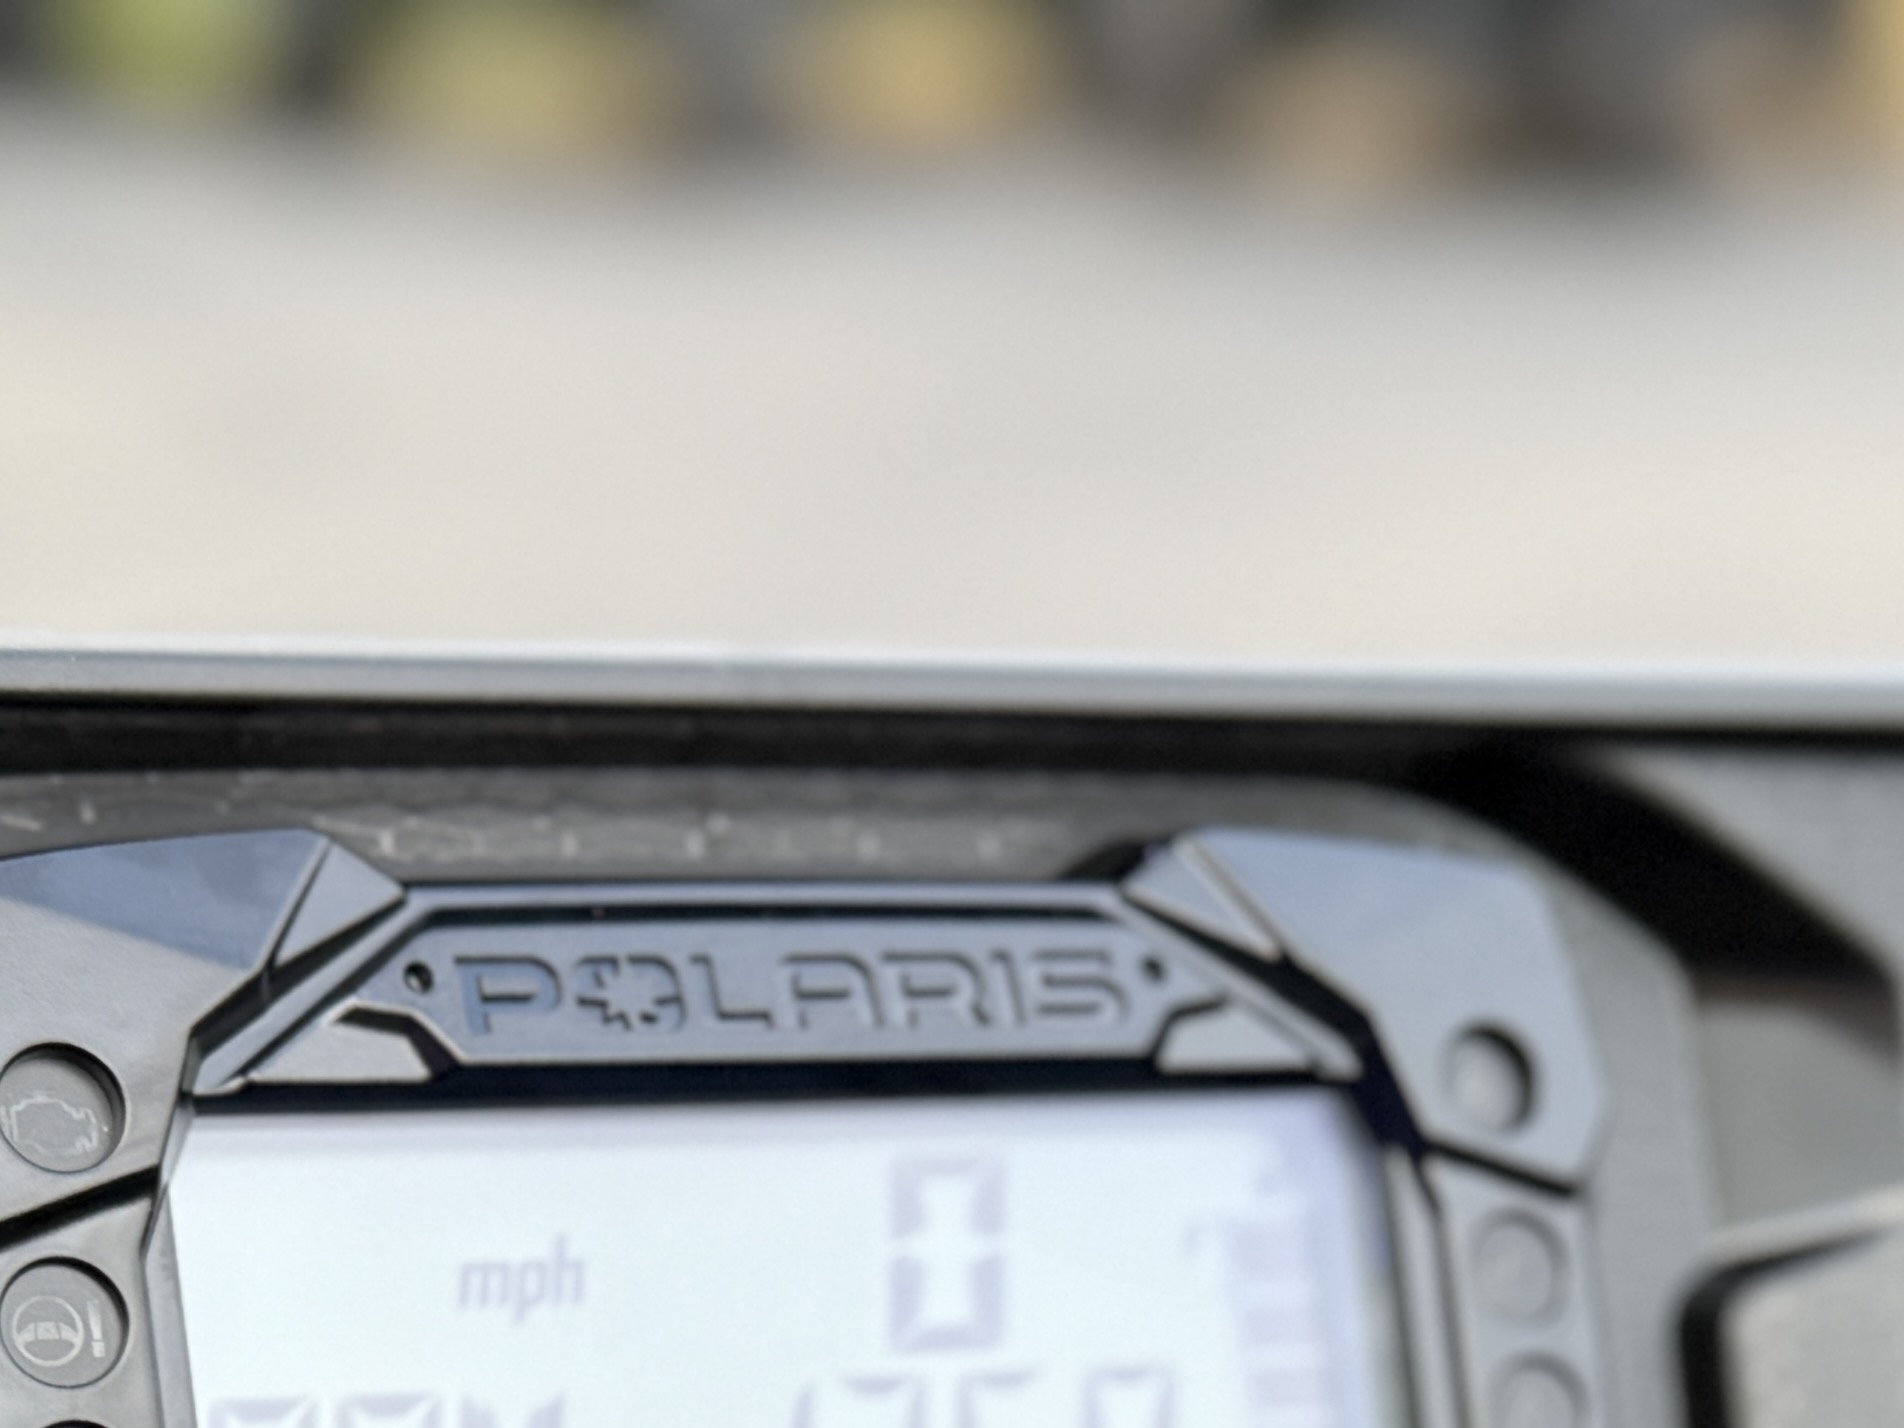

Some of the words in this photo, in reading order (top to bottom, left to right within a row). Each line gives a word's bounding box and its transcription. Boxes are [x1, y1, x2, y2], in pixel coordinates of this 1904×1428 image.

[453, 949, 1130, 1035] POLARIS
[456, 1231, 588, 1326] mph
[889, 1154, 1007, 1353] 0
